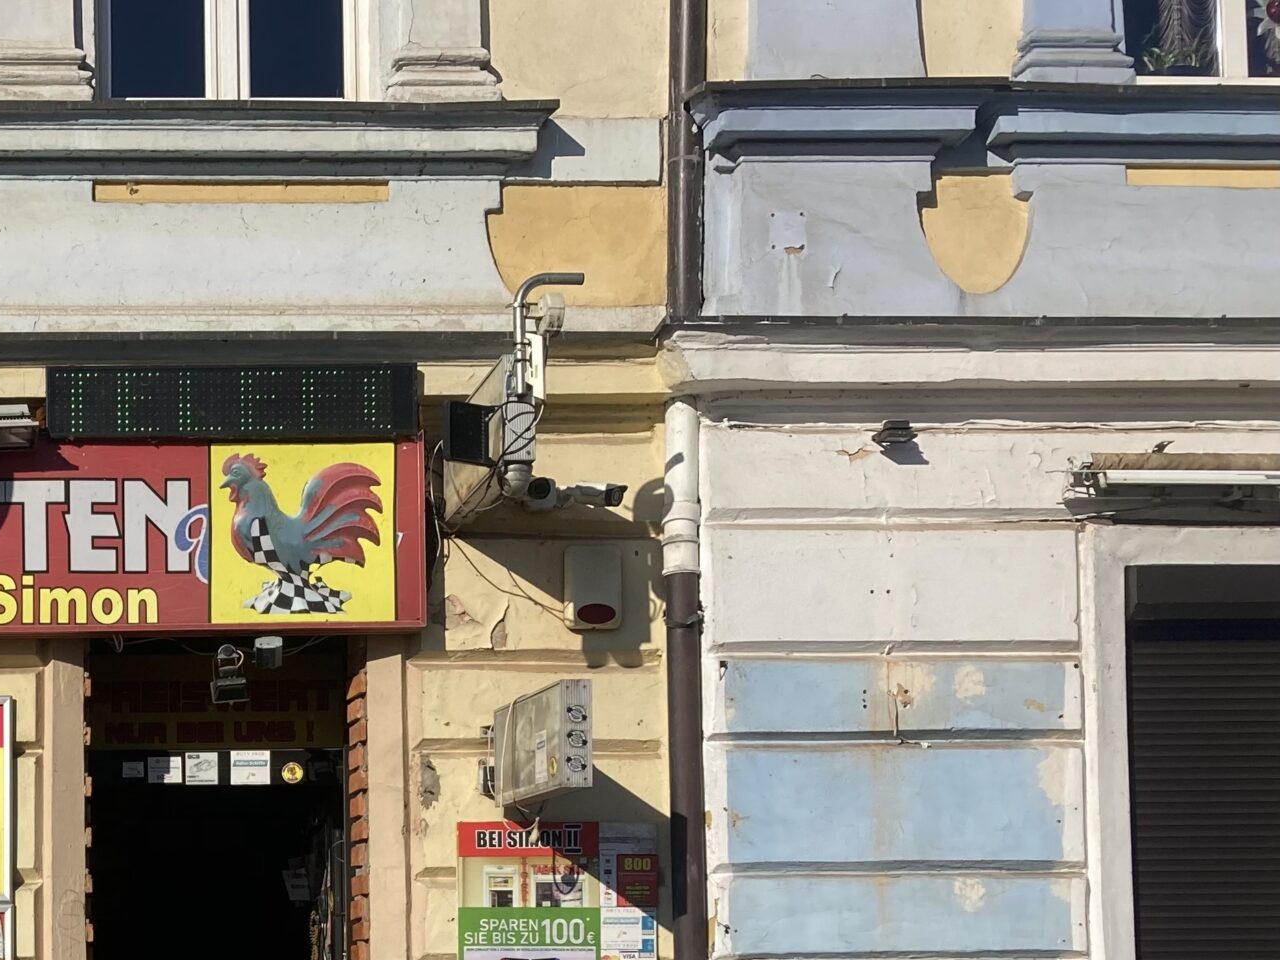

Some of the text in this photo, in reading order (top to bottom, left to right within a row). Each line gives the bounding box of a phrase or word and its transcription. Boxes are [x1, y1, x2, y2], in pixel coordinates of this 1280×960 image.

[475, 829, 503, 849] BEI
[479, 918, 539, 931] SPAREN
[464, 931, 539, 944] SIE BIS ZU
